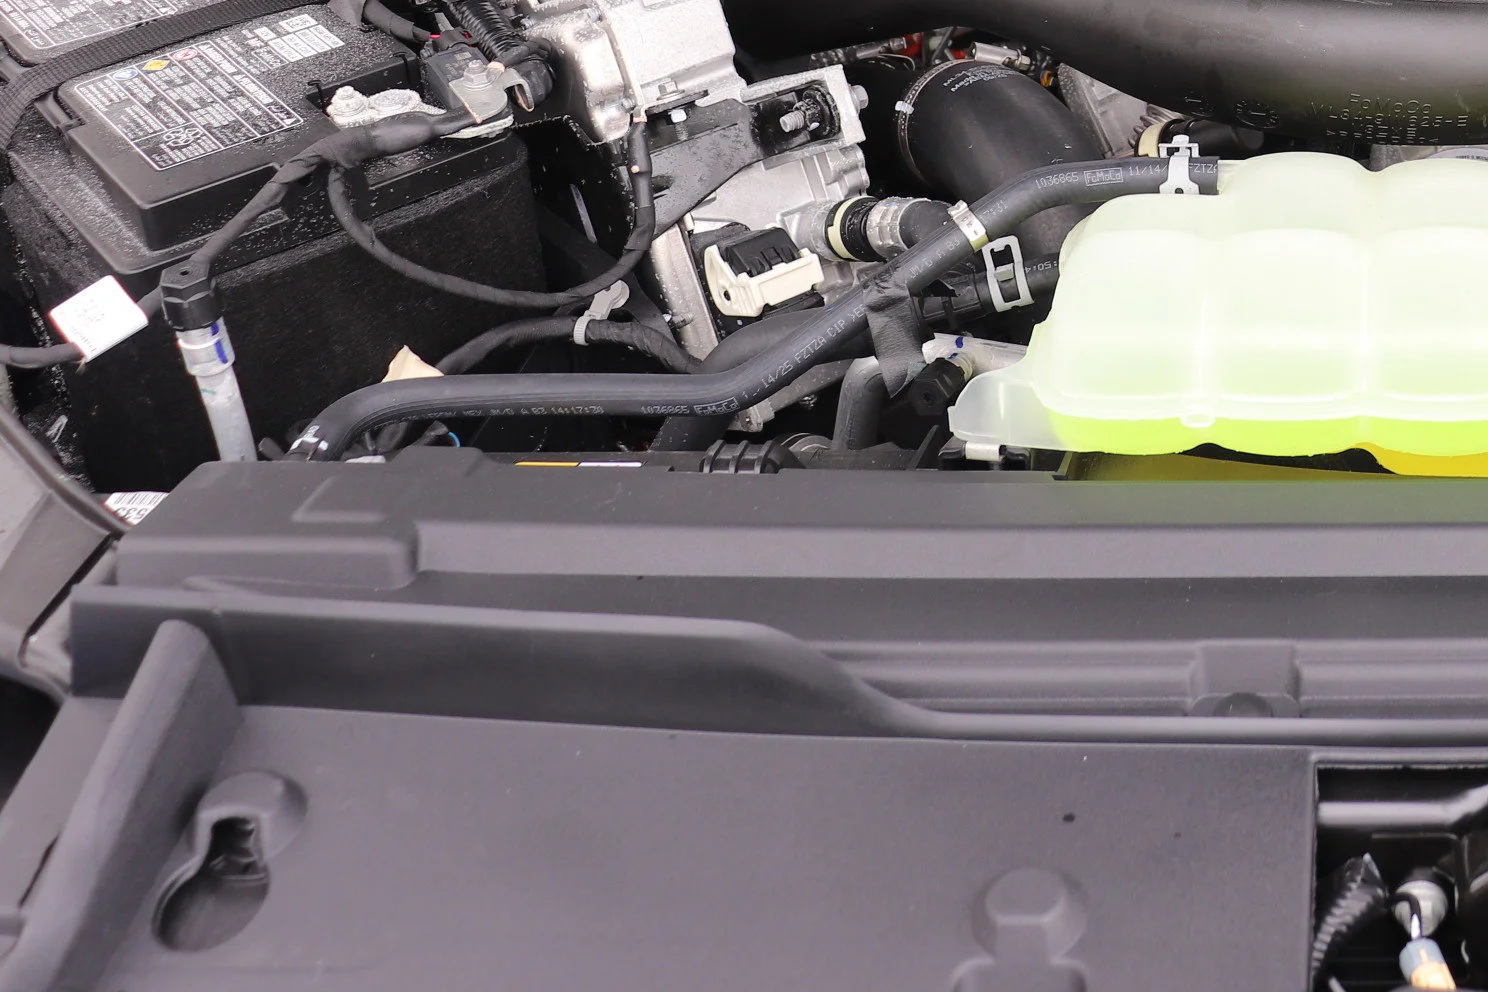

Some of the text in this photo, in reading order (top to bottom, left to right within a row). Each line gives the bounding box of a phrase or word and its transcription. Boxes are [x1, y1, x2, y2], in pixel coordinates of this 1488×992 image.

[1035, 171, 1079, 190] 1036865
[1086, 169, 1122, 185] FoMoCo
[1128, 162, 1168, 177] 11/14/
[697, 400, 738, 415] FoMoCo
[826, 318, 846, 338] CIP
